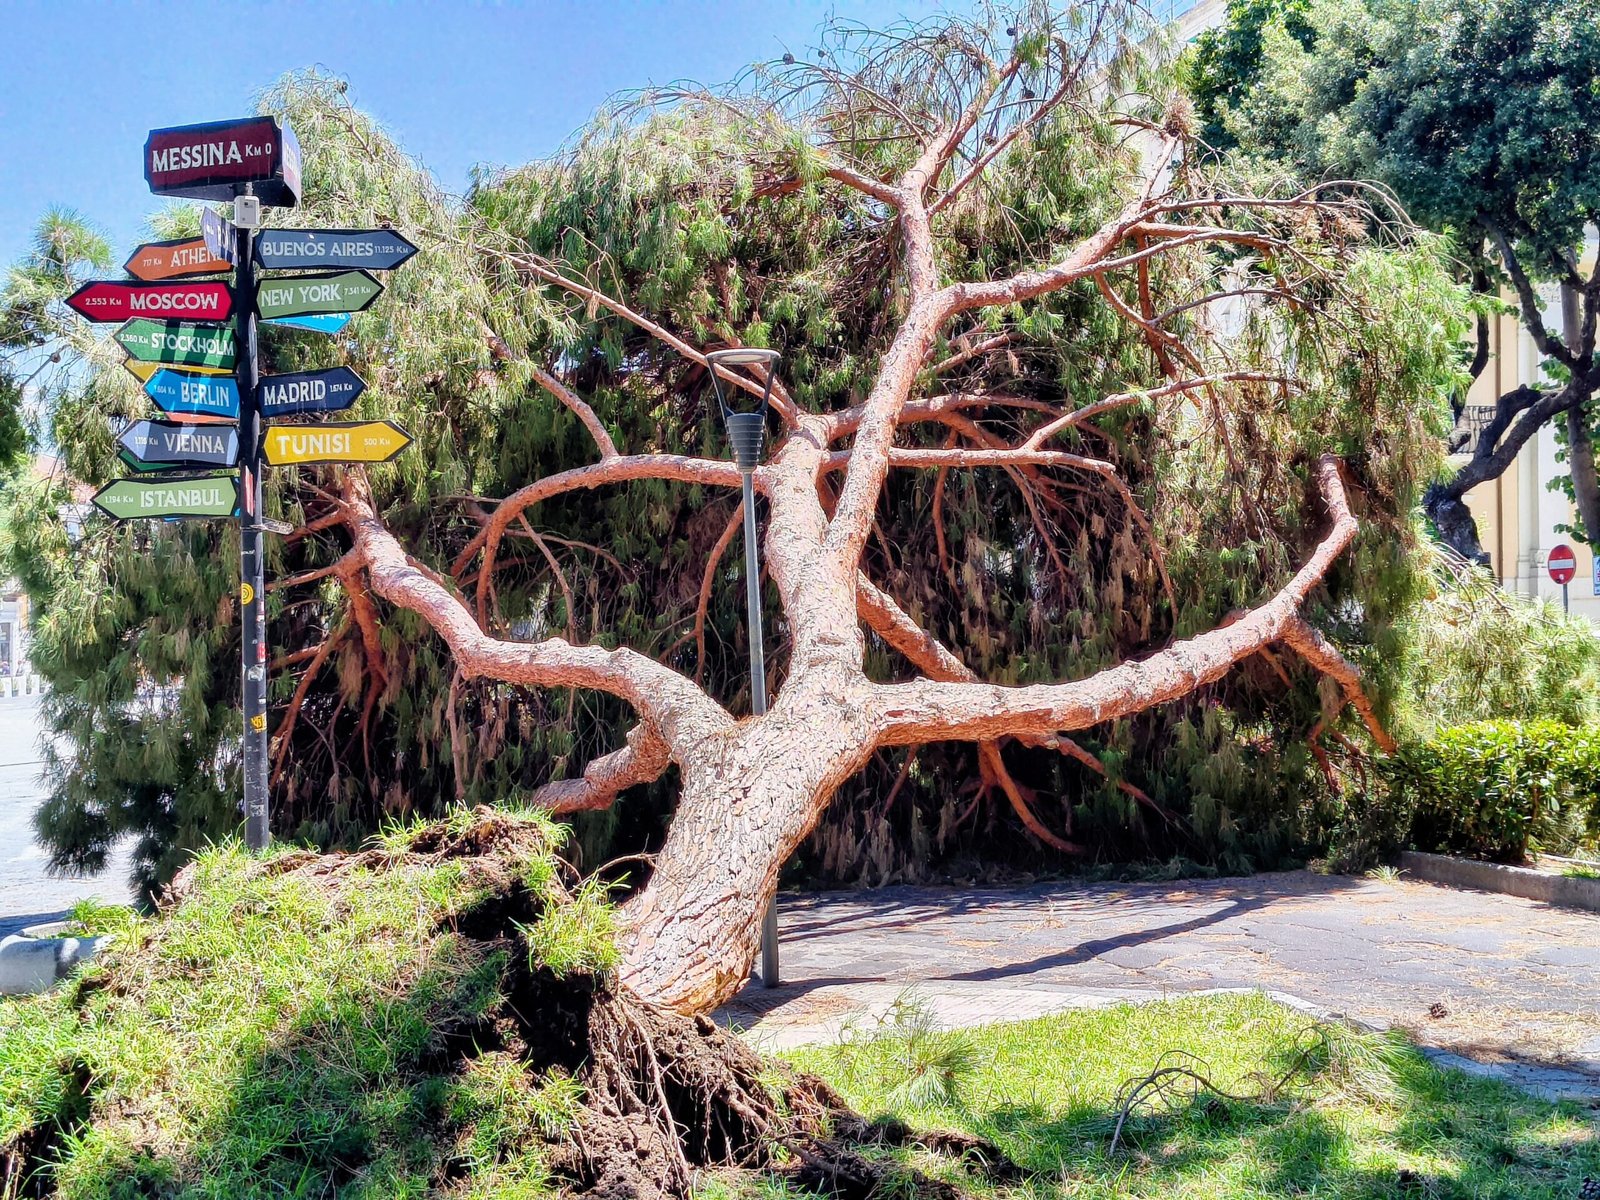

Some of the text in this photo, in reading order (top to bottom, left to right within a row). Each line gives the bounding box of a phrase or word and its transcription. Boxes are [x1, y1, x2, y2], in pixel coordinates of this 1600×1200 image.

[152, 141, 243, 173] MESSINA
[262, 242, 325, 257] BUENOS
[330, 242, 373, 257] AIRES
[375, 246, 394, 254] 11.125
[85, 297, 107, 306] 2.553
[130, 292, 219, 310] MOSCOW
[261, 287, 293, 307] NEW
[298, 283, 342, 303] YORK
[151, 332, 234, 356] STOCKHOLM
[180, 381, 230, 407] BERLIN
[263, 380, 326, 406] MADRID
[163, 433, 225, 454] VIENNA
[276, 433, 351, 457] TUNISI
[364, 438, 377, 446] 500
[140, 489, 225, 508] ISTANBUL
